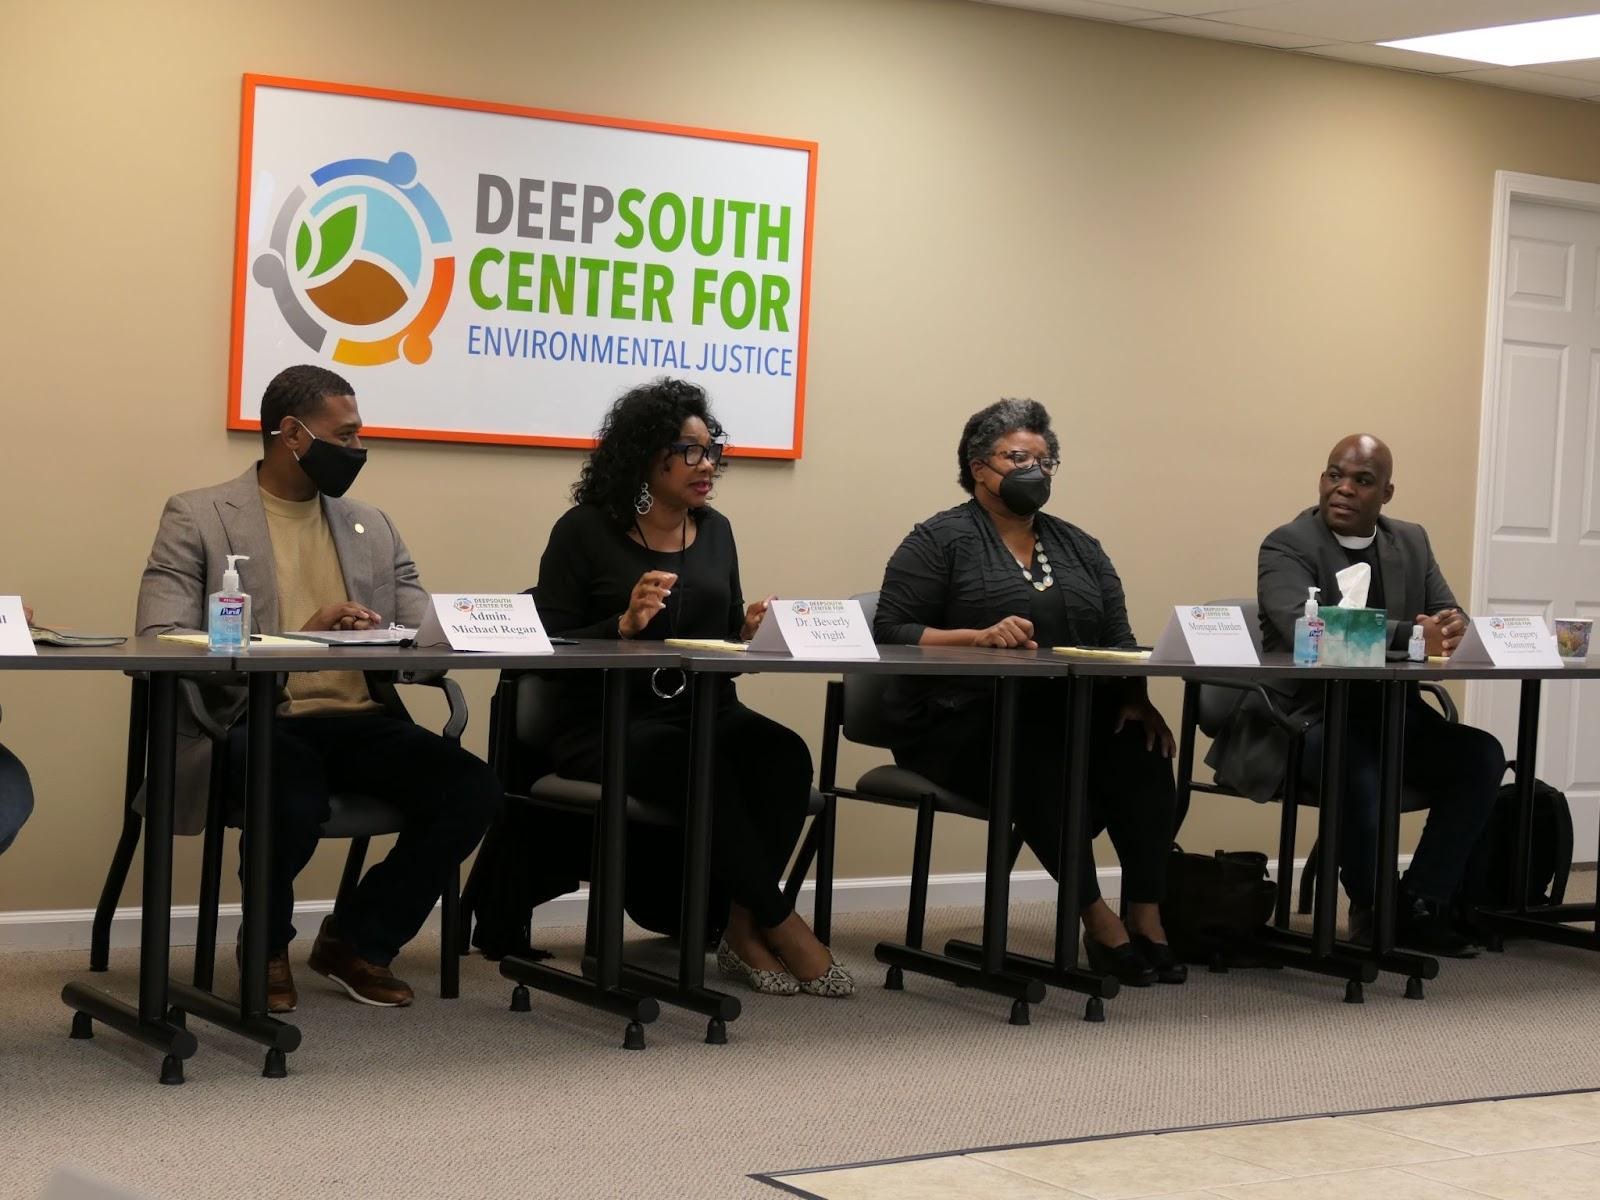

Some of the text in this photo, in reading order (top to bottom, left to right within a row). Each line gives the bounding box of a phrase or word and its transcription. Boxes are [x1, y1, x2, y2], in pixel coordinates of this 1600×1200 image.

[475, 173, 792, 262] DEEPSOUTH
[468, 247, 791, 333] CENTER FOR
[467, 324, 793, 377] ENVIRONMENTAL JUSTICE
[469, 612, 512, 621] Admin.
[794, 617, 850, 628] Dr. Beverly
[1188, 622, 1243, 632] Monique Harden
[451, 624, 538, 635] Michael Regan
[811, 631, 846, 642] Wright
[1509, 631, 1538, 640] Gregory
